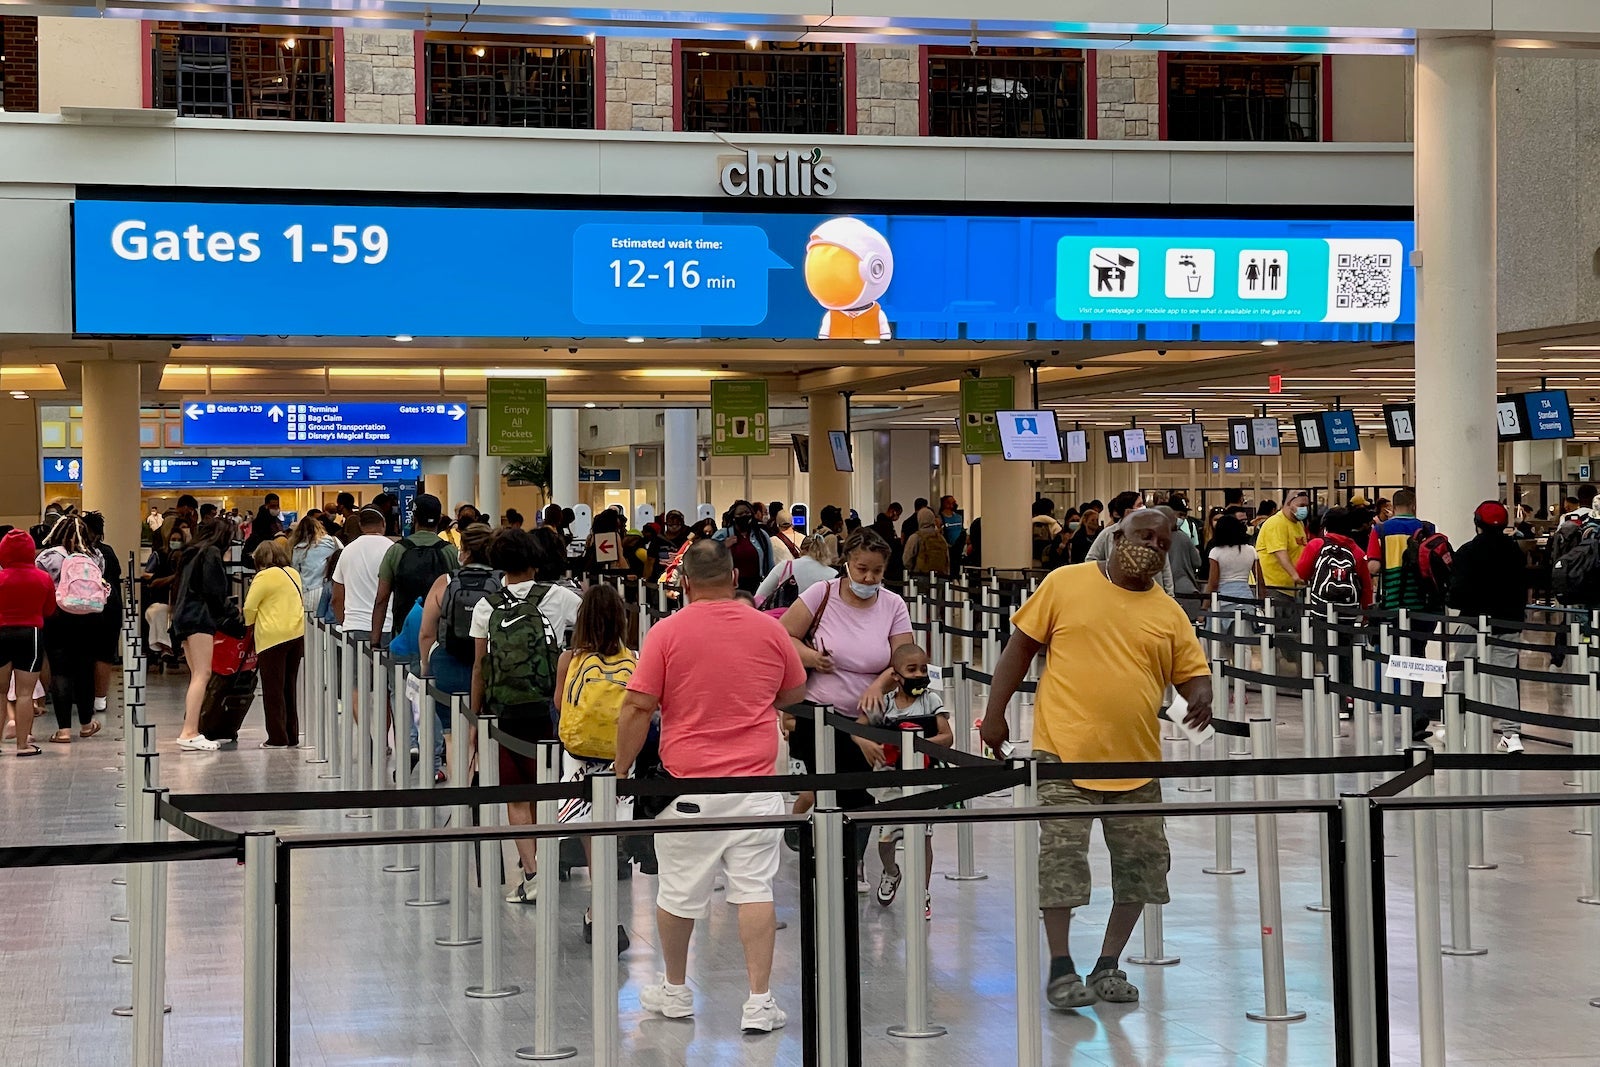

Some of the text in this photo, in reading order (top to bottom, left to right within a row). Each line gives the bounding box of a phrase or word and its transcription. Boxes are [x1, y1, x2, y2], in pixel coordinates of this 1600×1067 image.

[721, 147, 838, 197] chili's
[111, 220, 389, 265] Gates 1-59
[611, 238, 722, 250] Estimated wait time:
[609, 260, 736, 289] 12-16 min
[1105, 307, 1135, 316] webpage
[1167, 308, 1180, 316] app
[1200, 307, 1217, 315] what
[1271, 308, 1287, 316] gate
[217, 405, 263, 413] Gates 70-129
[308, 405, 338, 413] Terminal
[399, 405, 435, 413] Gates 1-59
[1541, 399, 1552, 409] TSA
[504, 405, 530, 415] Empty
[308, 414, 343, 423] Bag Claim
[511, 417, 523, 427] All
[1498, 409, 1516, 428] 13
[308, 423, 386, 432] Ground Transportation
[1394, 417, 1411, 434] 12
[1539, 421, 1562, 432] Screening
[308, 432, 391, 441] Disney's Magical Express
[501, 430, 533, 438] Pockets
[1235, 430, 1247, 445] 10
[1303, 426, 1316, 441] 11
[1113, 440, 1119, 453] 8
[1169, 435, 1175, 449] 9
[225, 459, 236, 467] Bag
